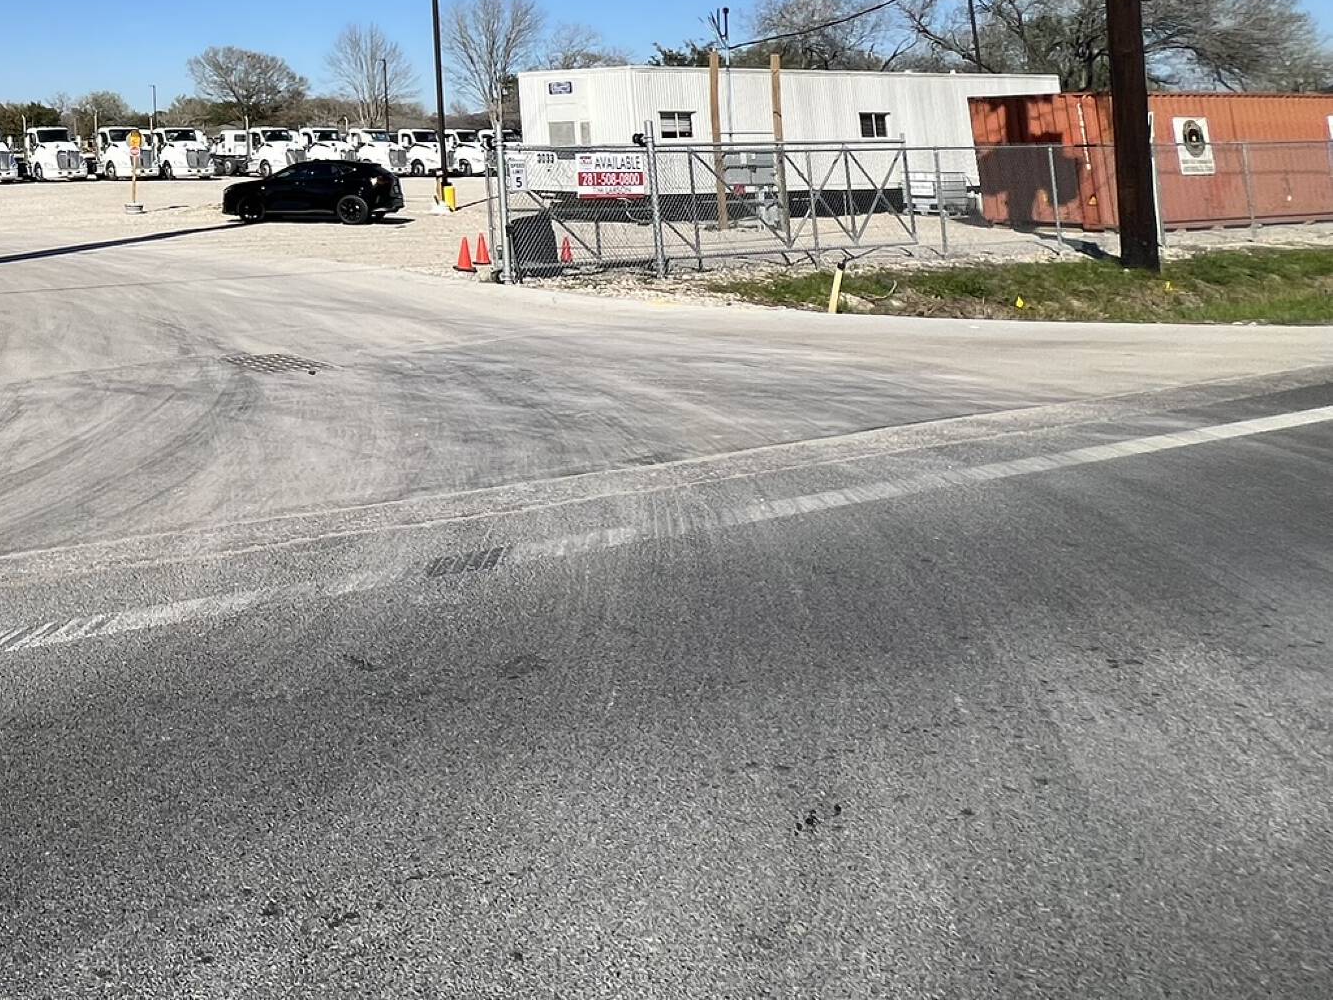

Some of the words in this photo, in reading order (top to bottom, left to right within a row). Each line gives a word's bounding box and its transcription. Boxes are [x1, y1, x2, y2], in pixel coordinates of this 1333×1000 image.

[594, 155, 641, 169] AVAILABLE
[516, 177, 522, 188] 5
[581, 172, 640, 186] 281-508-0800
